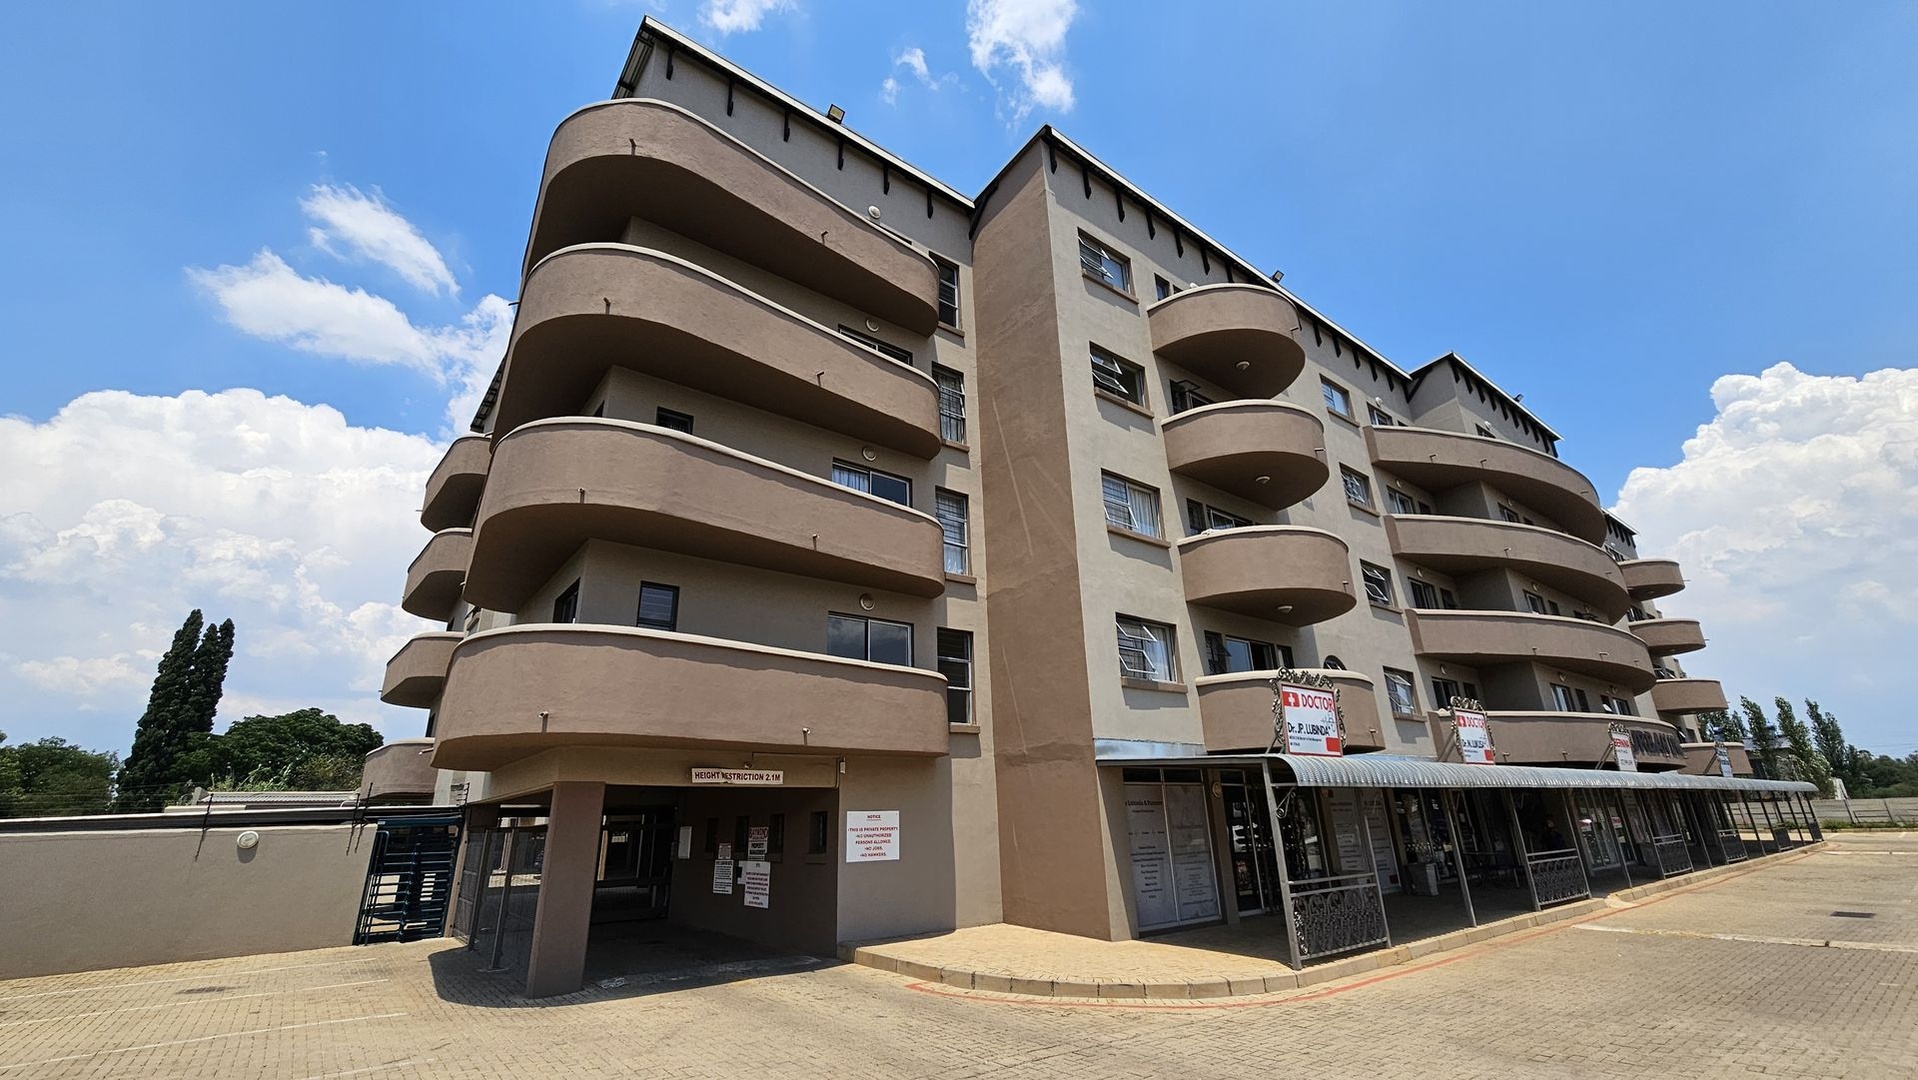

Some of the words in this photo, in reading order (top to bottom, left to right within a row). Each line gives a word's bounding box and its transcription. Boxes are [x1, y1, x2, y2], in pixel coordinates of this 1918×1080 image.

[1301, 694, 1335, 711] DOCTOR
[694, 771, 720, 780] HEIGHT
[721, 772, 764, 781] RESTRICTION
[765, 773, 781, 781] 2.1M
